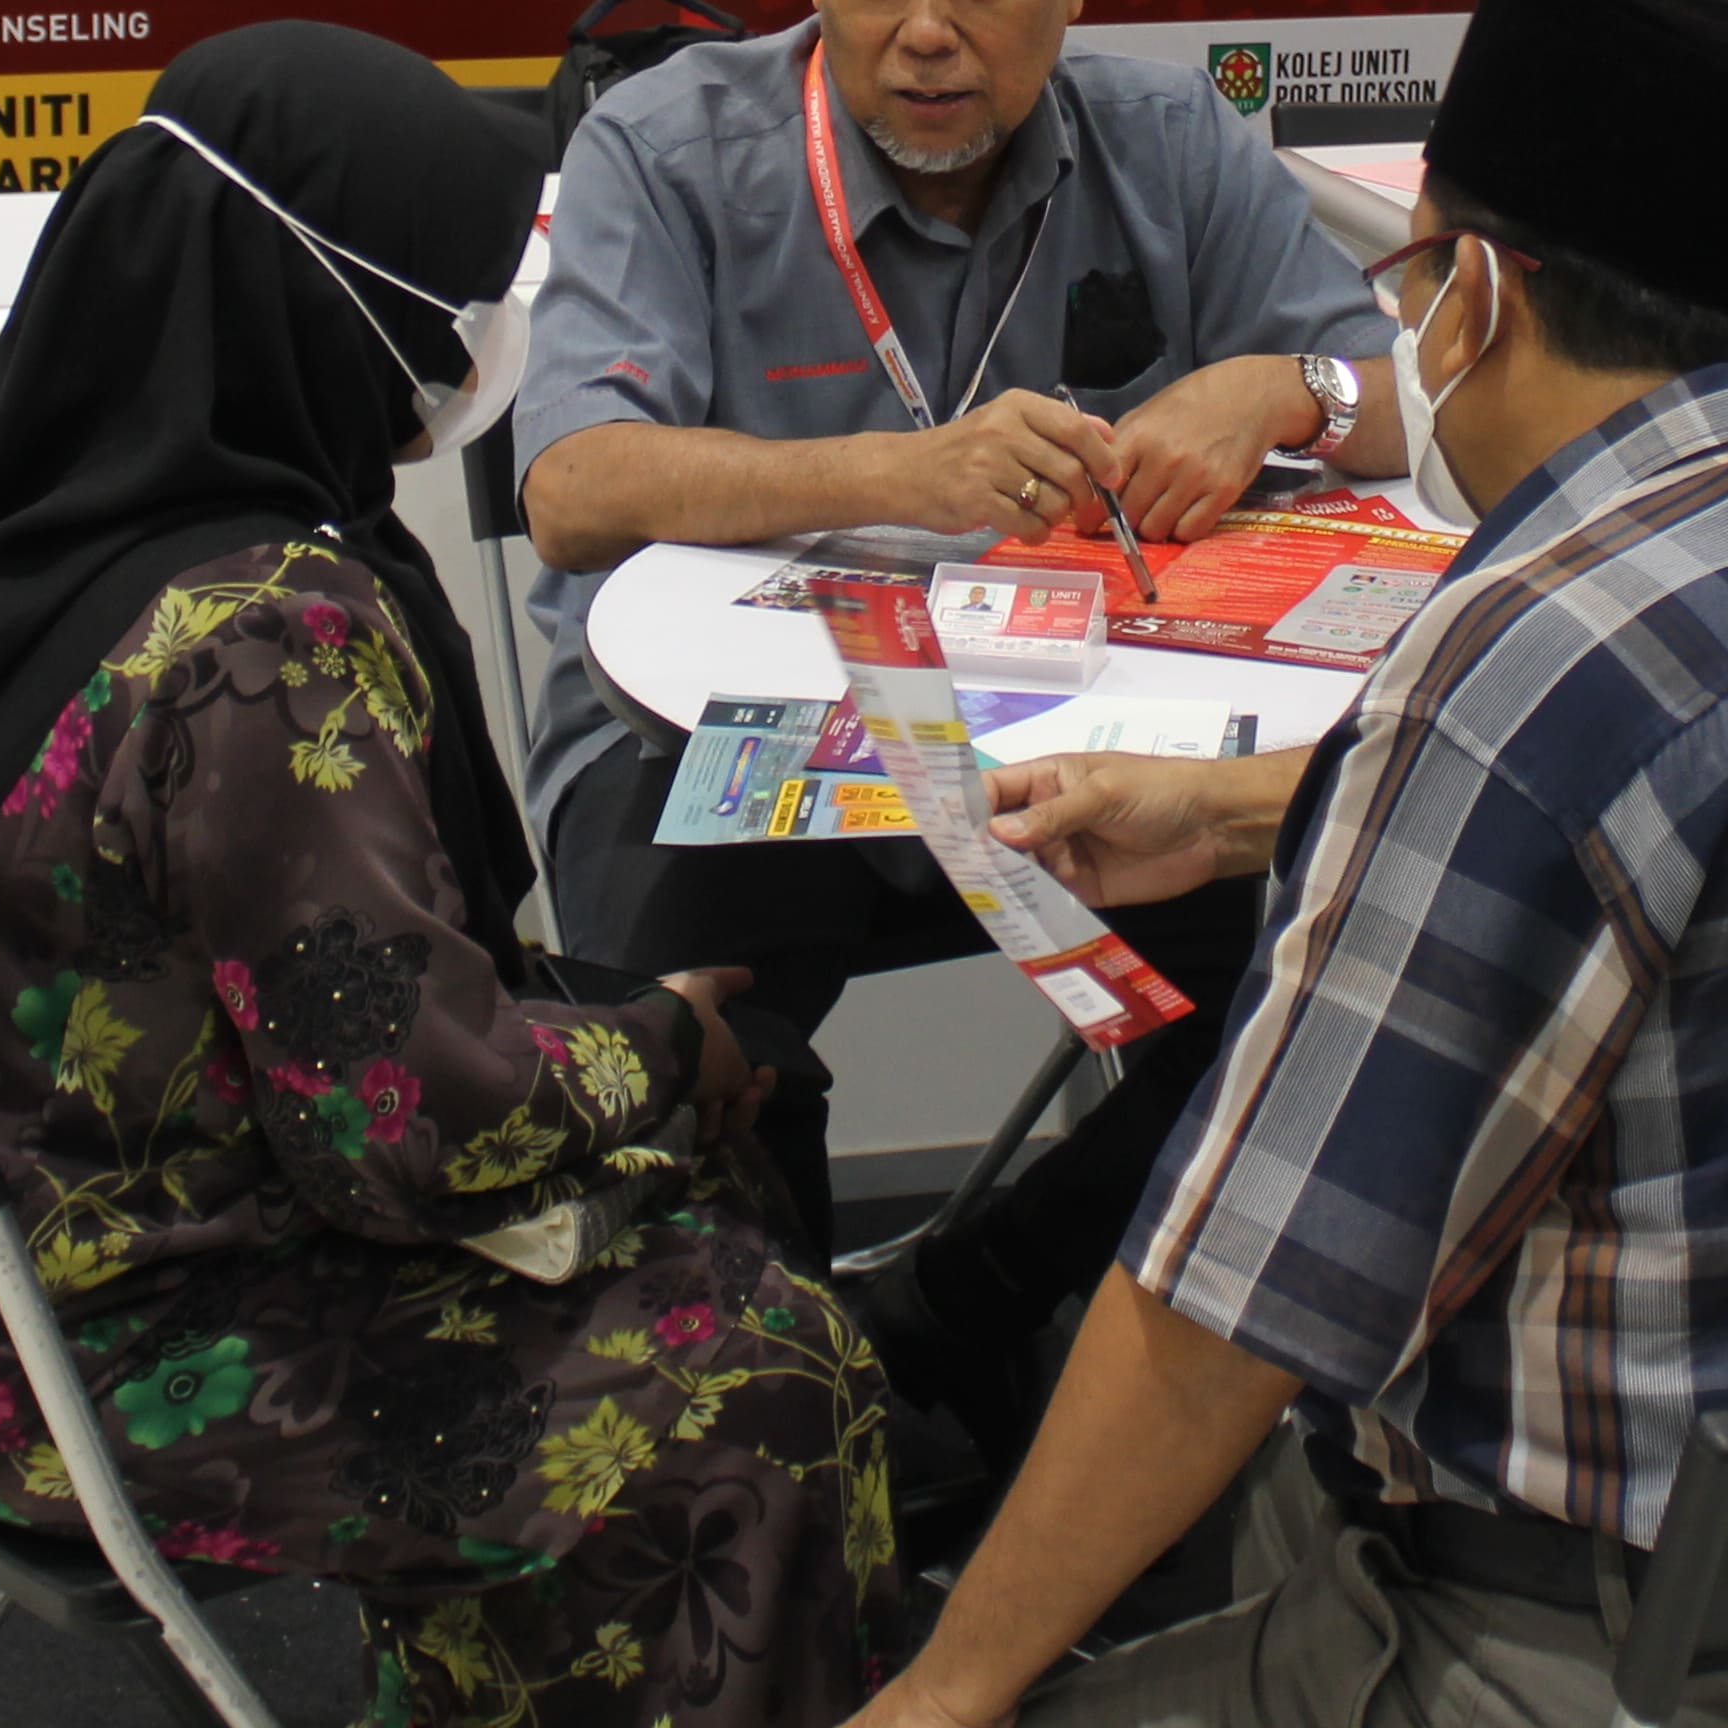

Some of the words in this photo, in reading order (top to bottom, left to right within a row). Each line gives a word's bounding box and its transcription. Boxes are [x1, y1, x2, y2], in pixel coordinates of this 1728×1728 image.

[1276, 51, 1342, 79] KOLEJ
[1351, 48, 1409, 77] UNITI
[1276, 84, 1332, 104] PORT
[1341, 80, 1436, 103] DICKSON
